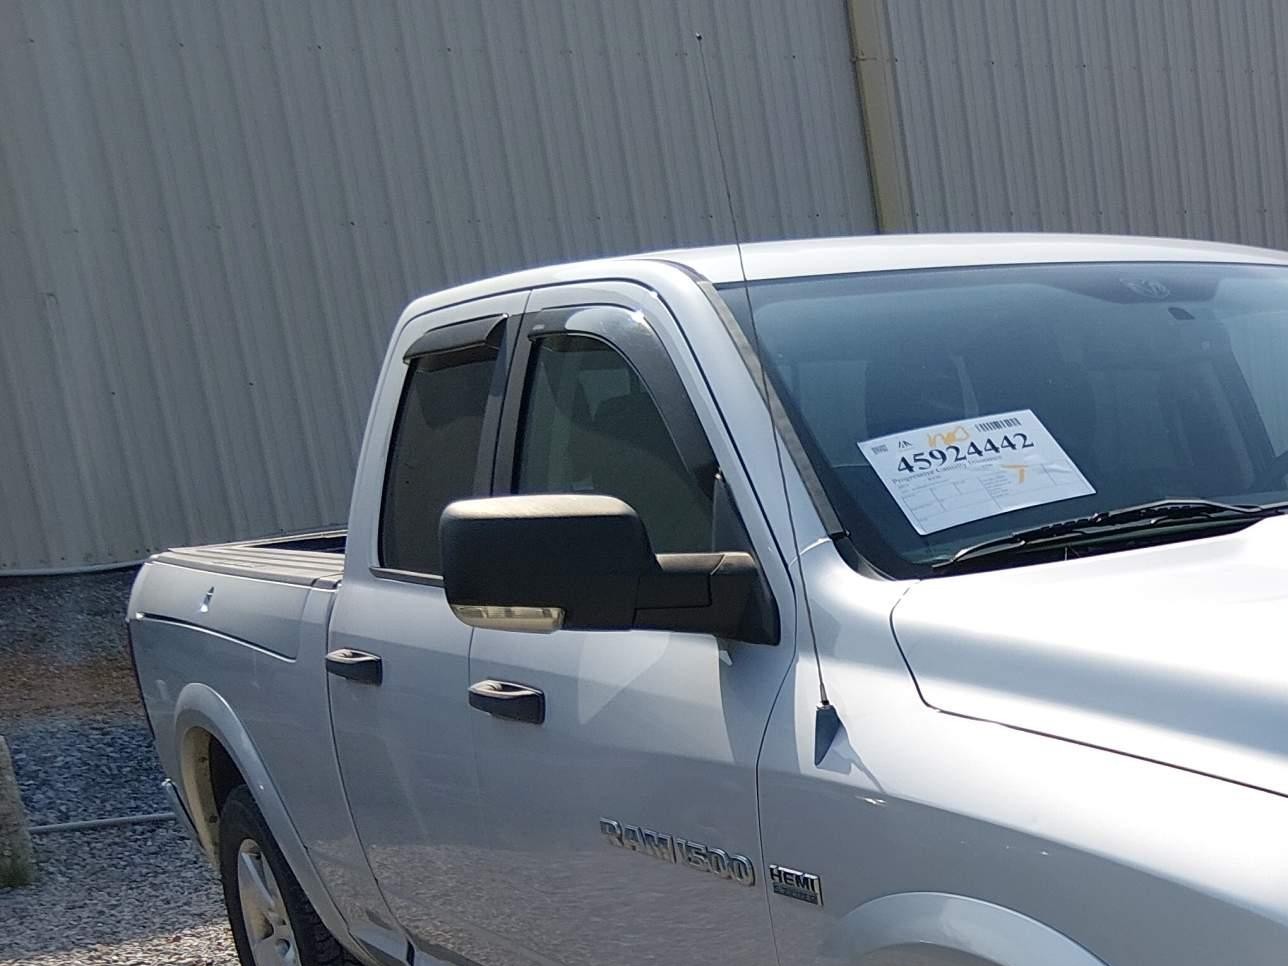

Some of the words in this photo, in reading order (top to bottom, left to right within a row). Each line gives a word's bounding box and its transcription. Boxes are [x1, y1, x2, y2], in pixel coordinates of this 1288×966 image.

[897, 432, 1034, 474] 45924442
[599, 817, 677, 864] RAM
[676, 837, 756, 886] 1500
[769, 864, 819, 894] HEMI
